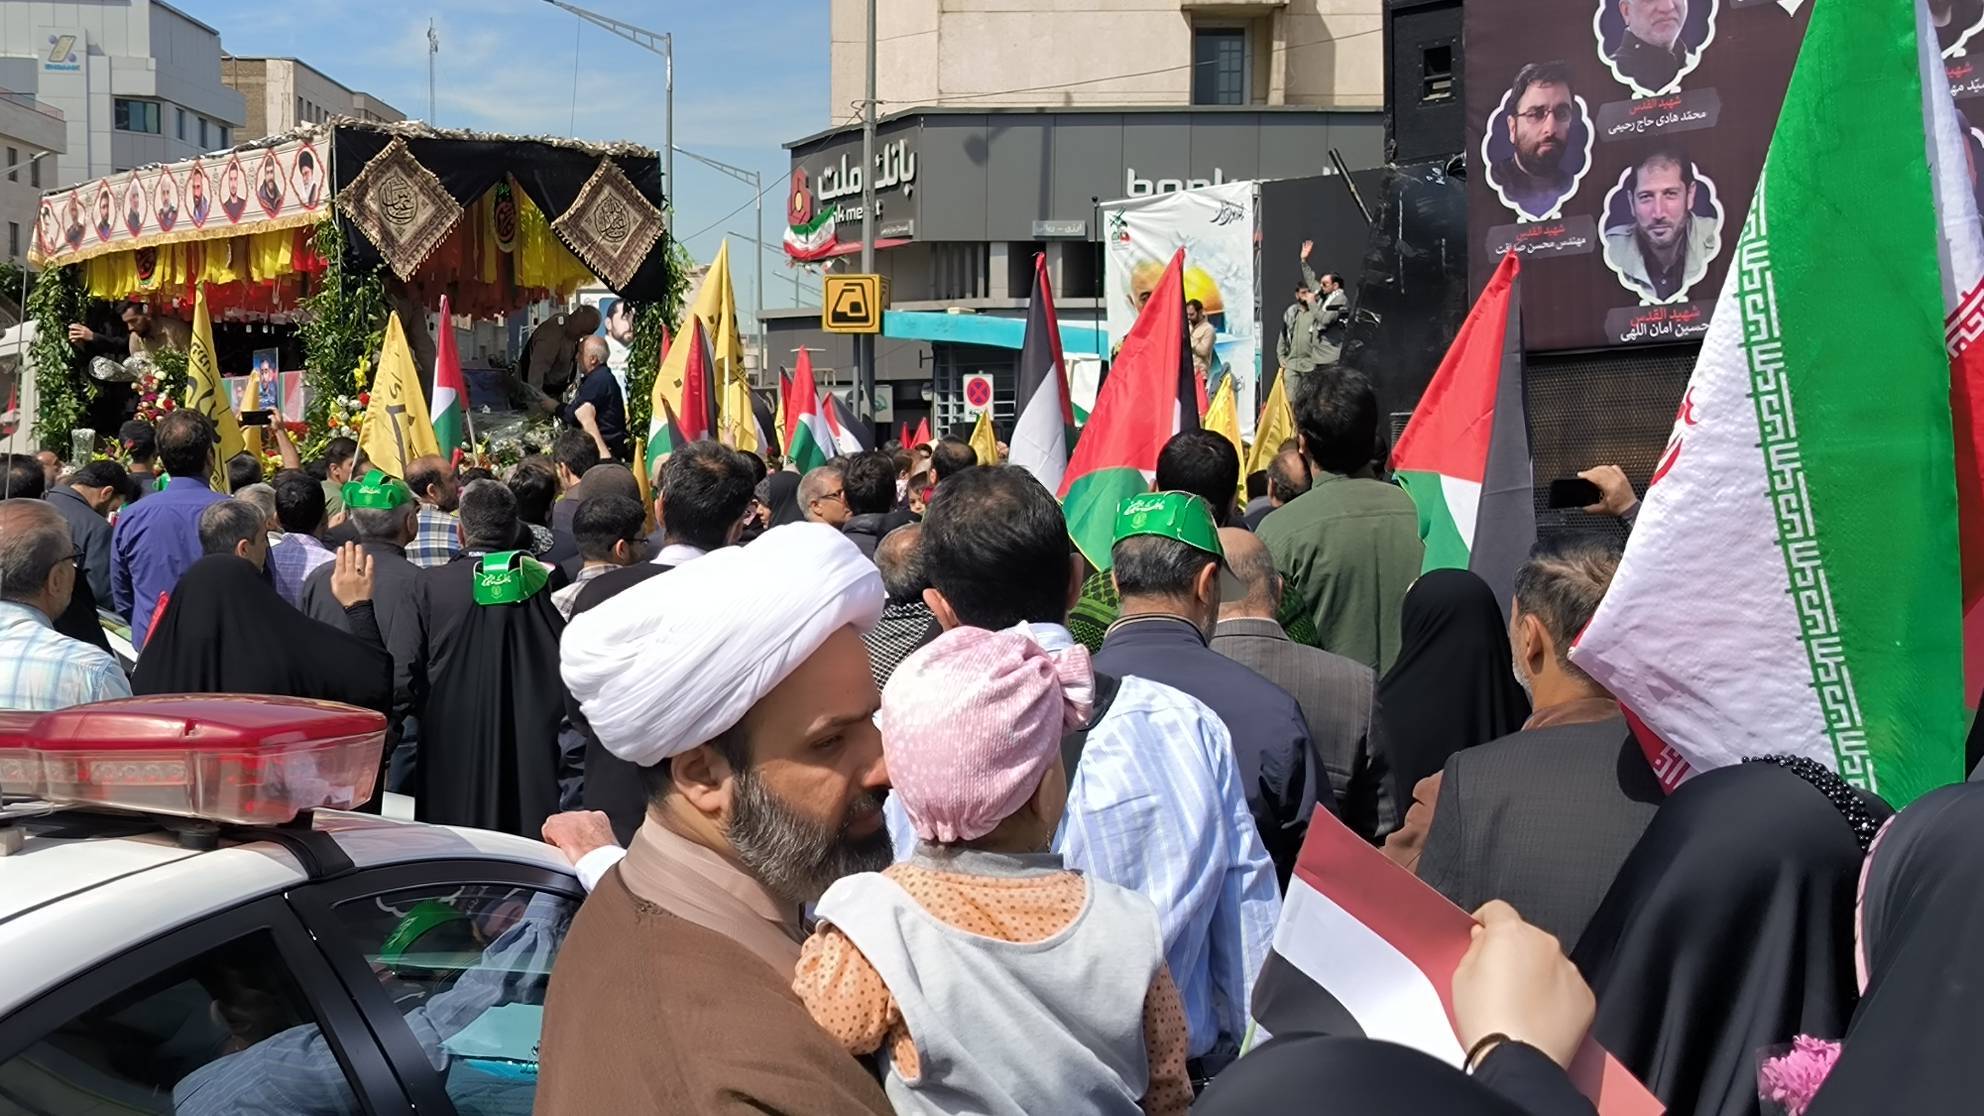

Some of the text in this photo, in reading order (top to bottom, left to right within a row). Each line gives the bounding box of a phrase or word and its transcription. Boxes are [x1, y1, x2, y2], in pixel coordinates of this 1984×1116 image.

[1629, 95, 1682, 116] شهید القدس
[1636, 116, 1655, 133] حاج
[1655, 112, 1679, 127] هادی
[1607, 121, 1636, 135] رحیمی
[817, 153, 863, 201] ملت
[1544, 223, 1566, 237] شهید
[1527, 241, 1555, 253] محسن
[1555, 236, 1586, 250] مهندس
[1630, 305, 1701, 326] شهید القدس
[1649, 321, 1673, 337] امان
[1675, 321, 1710, 337] حسین
